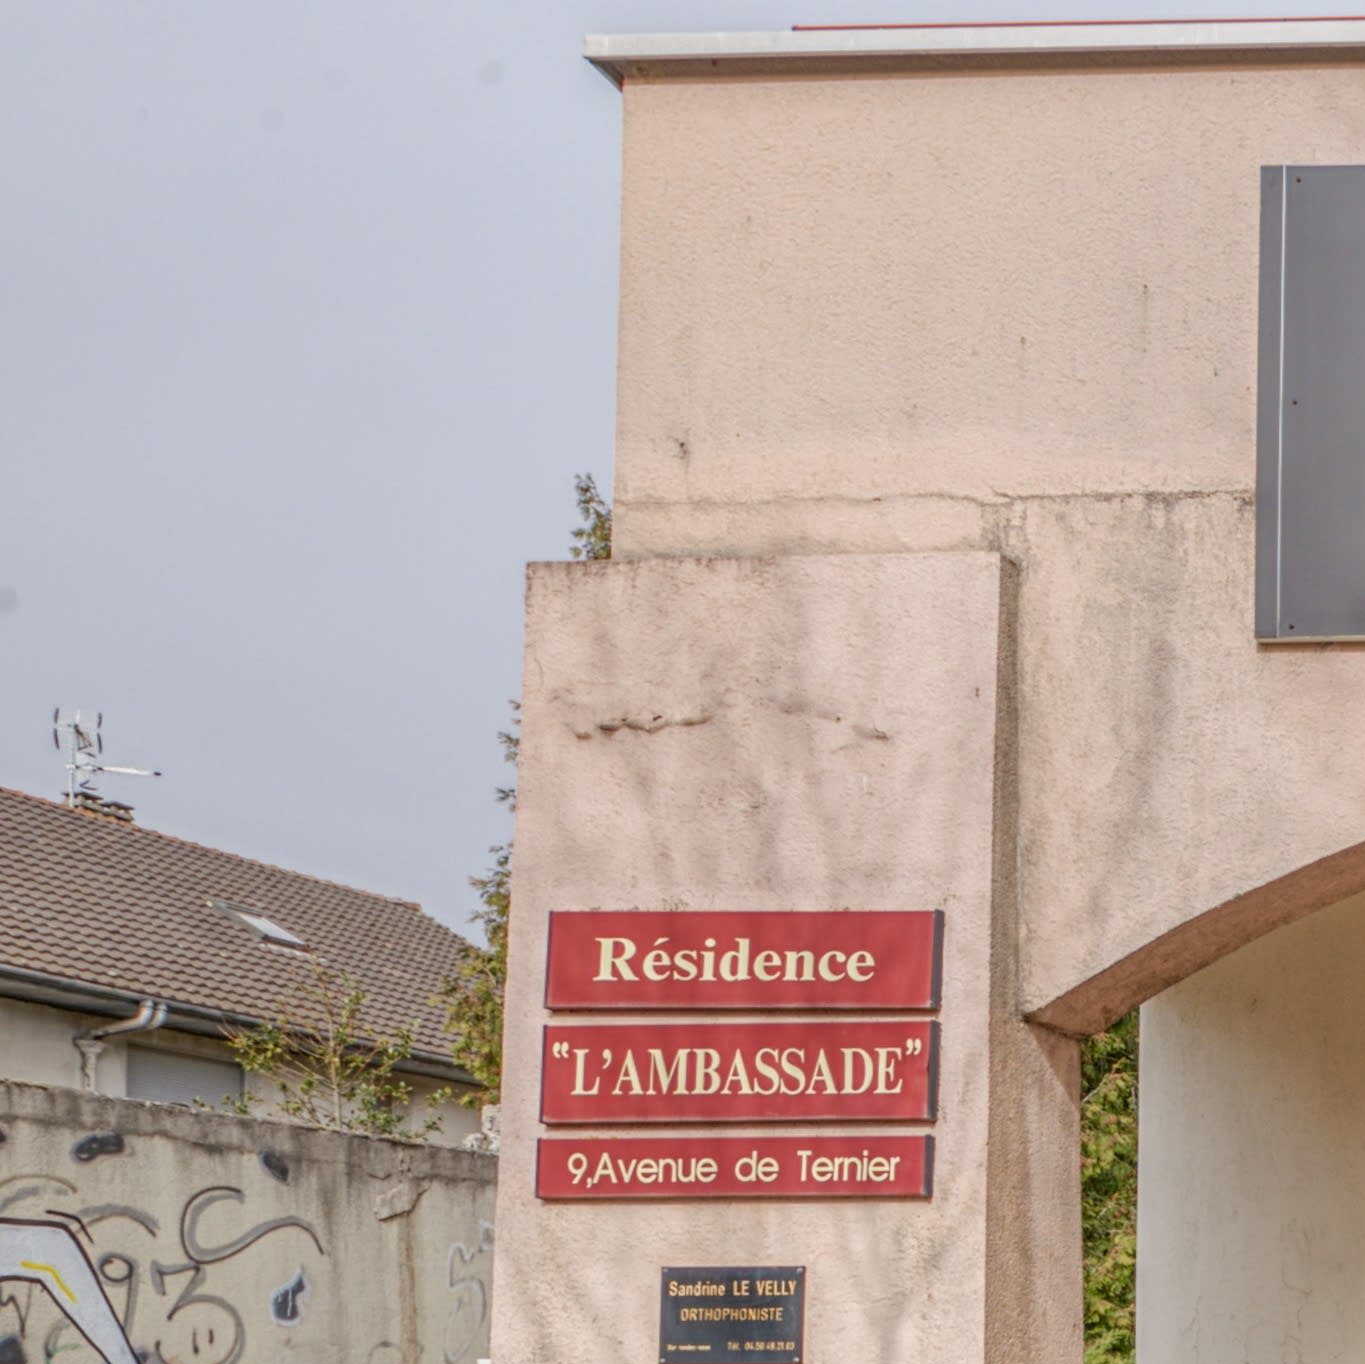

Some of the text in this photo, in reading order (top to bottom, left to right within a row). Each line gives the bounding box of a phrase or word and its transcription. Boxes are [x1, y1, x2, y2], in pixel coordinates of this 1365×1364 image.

[592, 936, 876, 983] Résidence
[552, 1038, 923, 1097] "L'AMBASSADE"
[734, 1150, 780, 1183] de
[796, 1149, 901, 1183] Ternier
[668, 1280, 797, 1297] Sandrine LE VELLY
[680, 1307, 784, 1322] ORTHOPHONISTE
